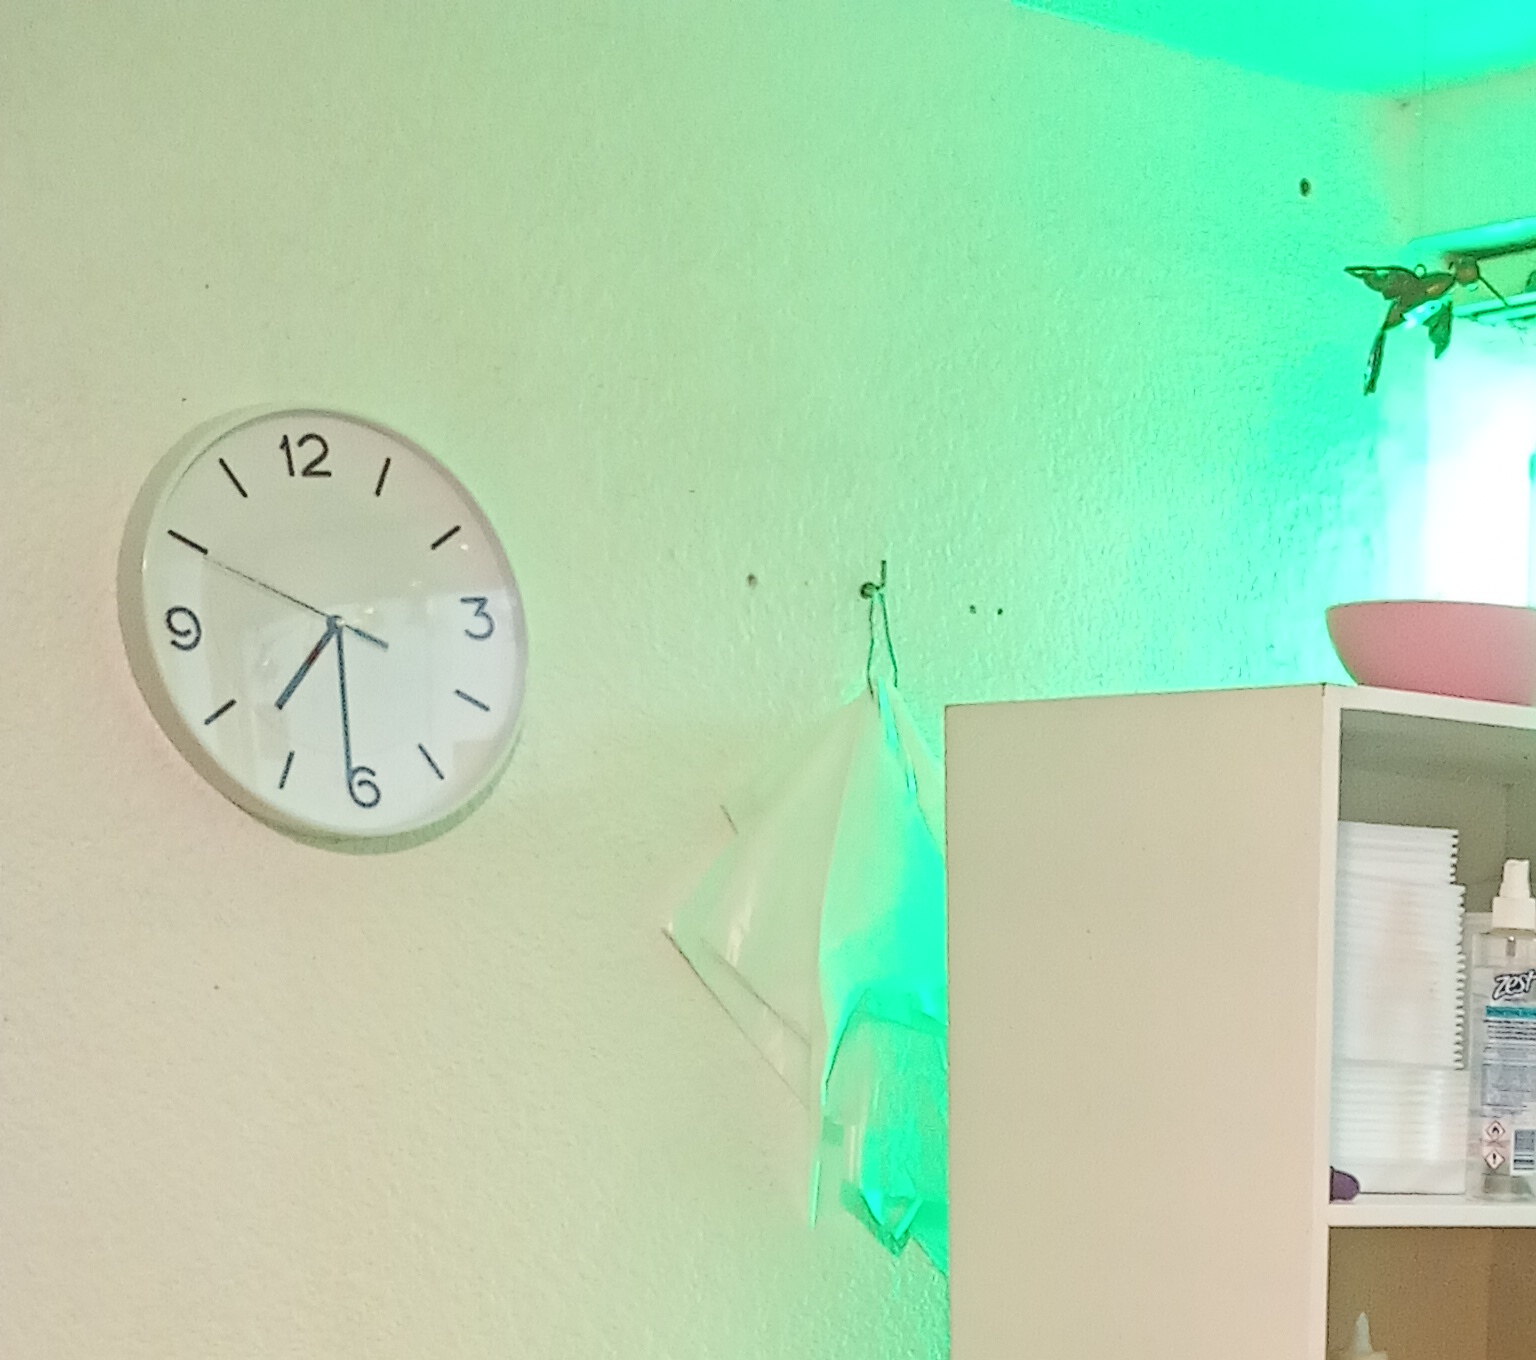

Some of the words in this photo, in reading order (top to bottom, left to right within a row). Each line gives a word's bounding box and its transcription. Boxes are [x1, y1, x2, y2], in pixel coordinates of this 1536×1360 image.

[279, 433, 331, 477] 12
[166, 606, 201, 651] 9
[460, 596, 495, 640] 3
[348, 766, 381, 808] 6
